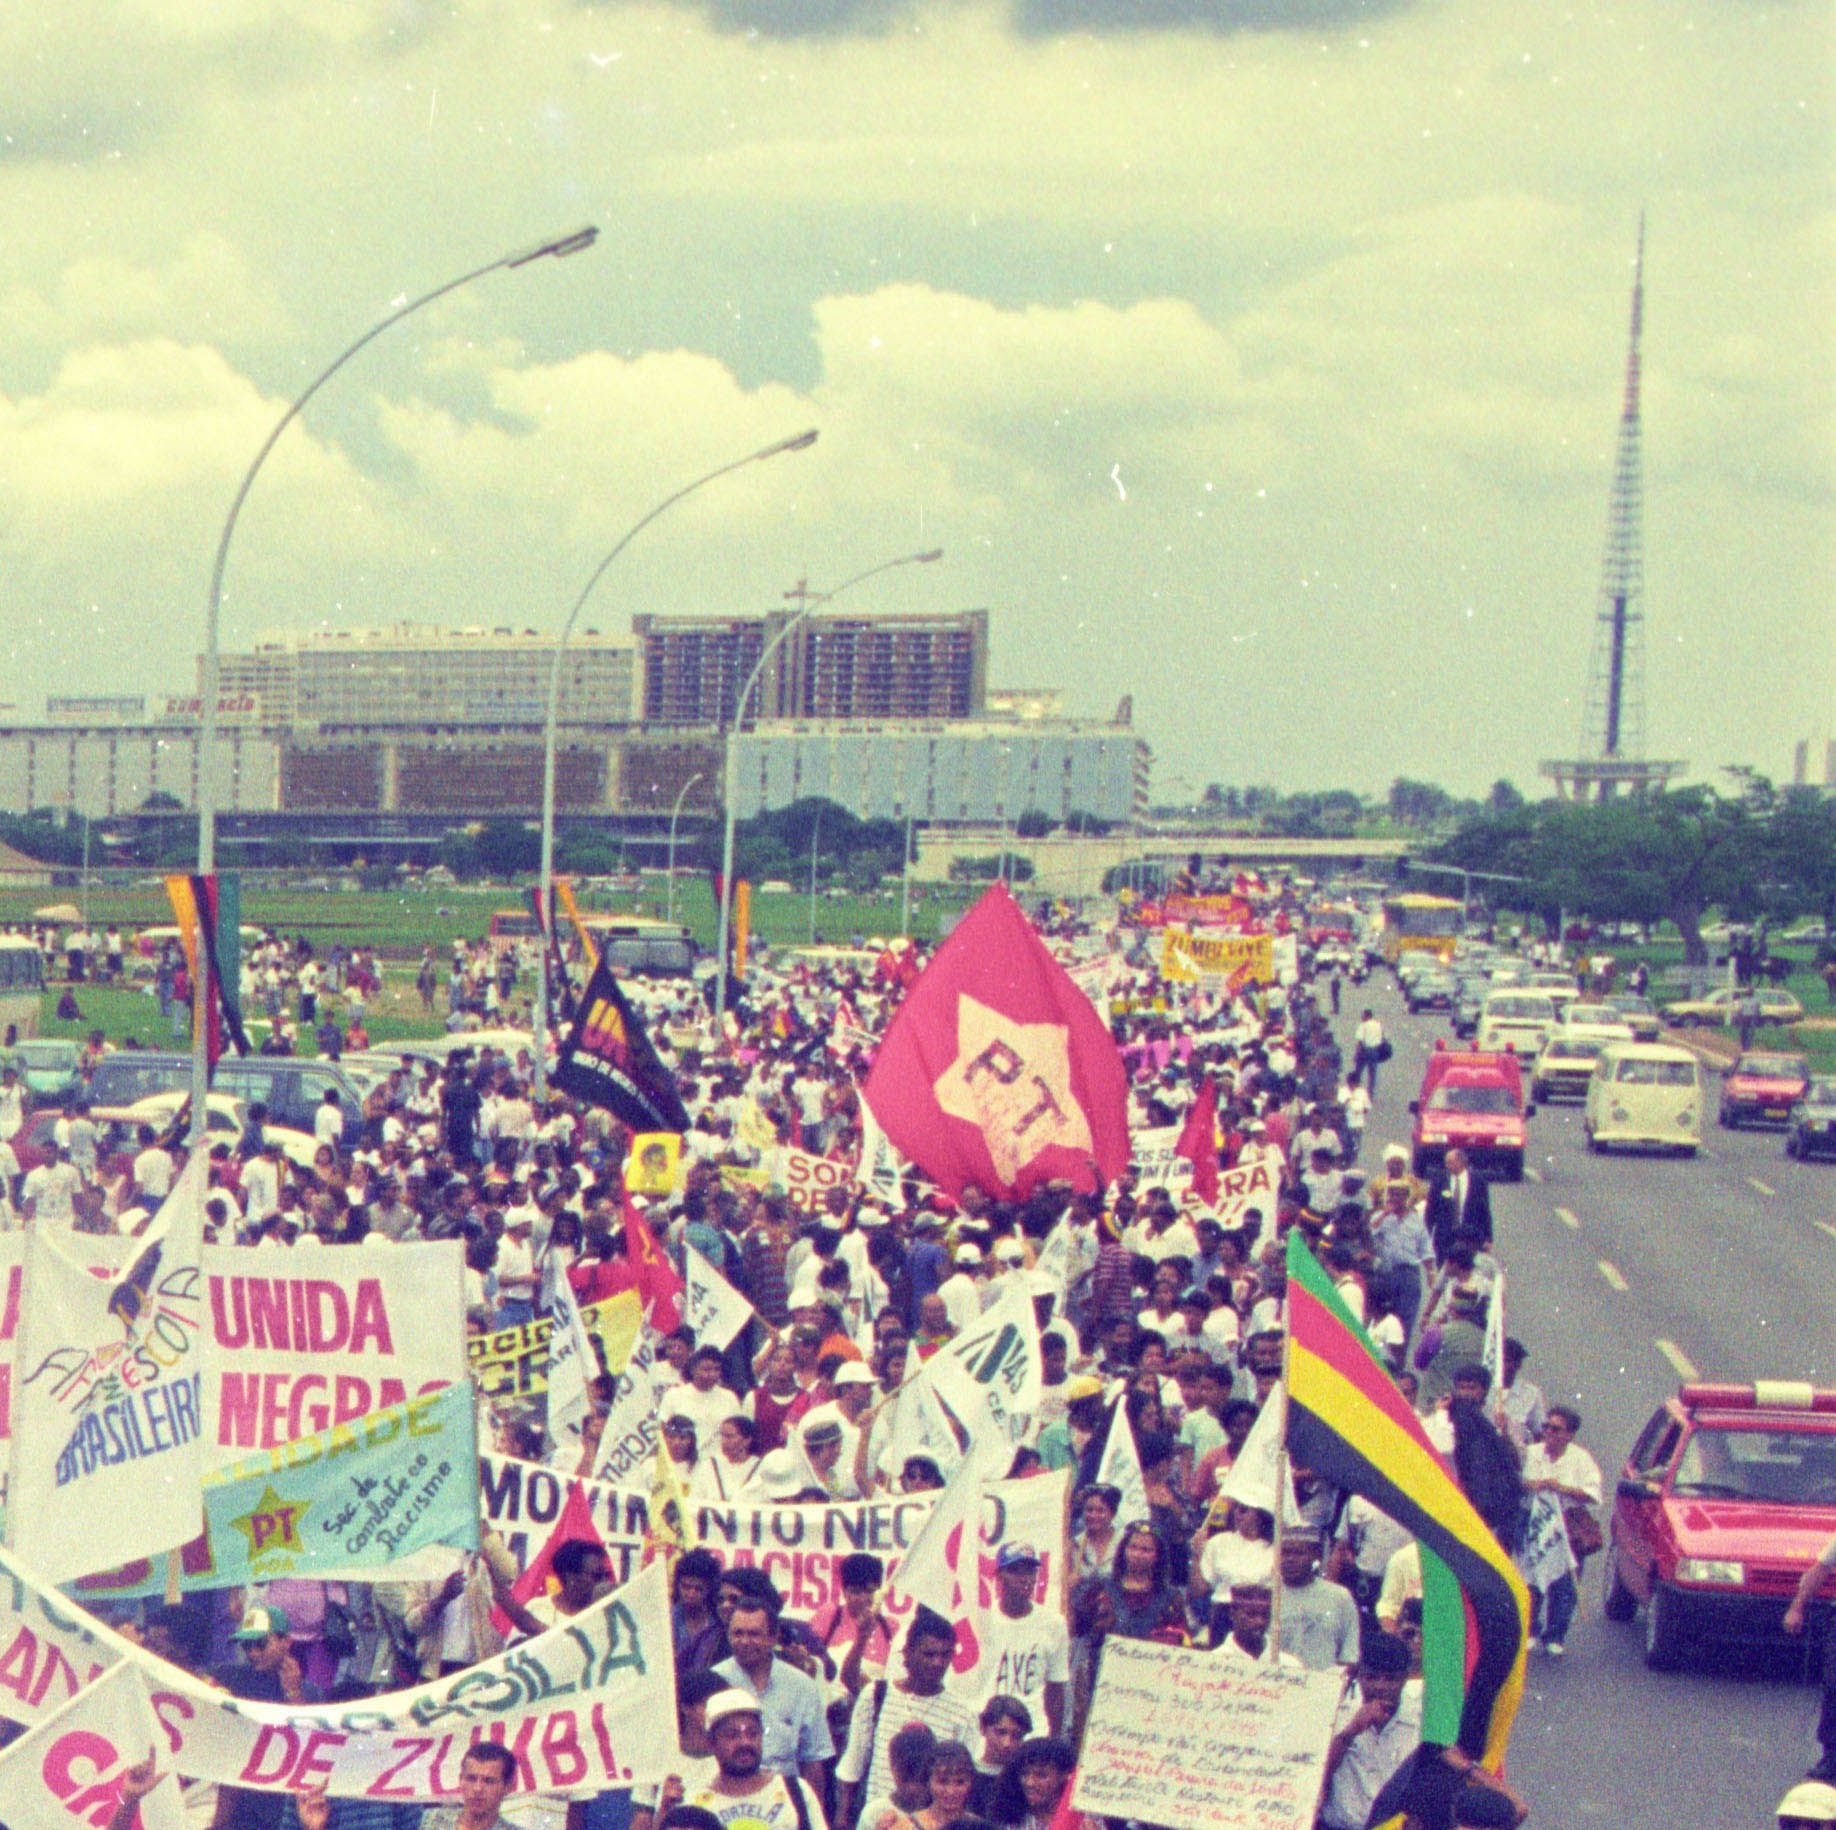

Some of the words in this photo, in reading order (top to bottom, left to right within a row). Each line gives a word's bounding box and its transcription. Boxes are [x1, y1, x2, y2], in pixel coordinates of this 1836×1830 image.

[963, 1038, 1070, 1135] PT
[209, 1276, 394, 1355] UNIDA
[218, 1372, 452, 1450] NEGR
[251, 1507, 295, 1548] PT
[238, 1724, 347, 1790] DE
